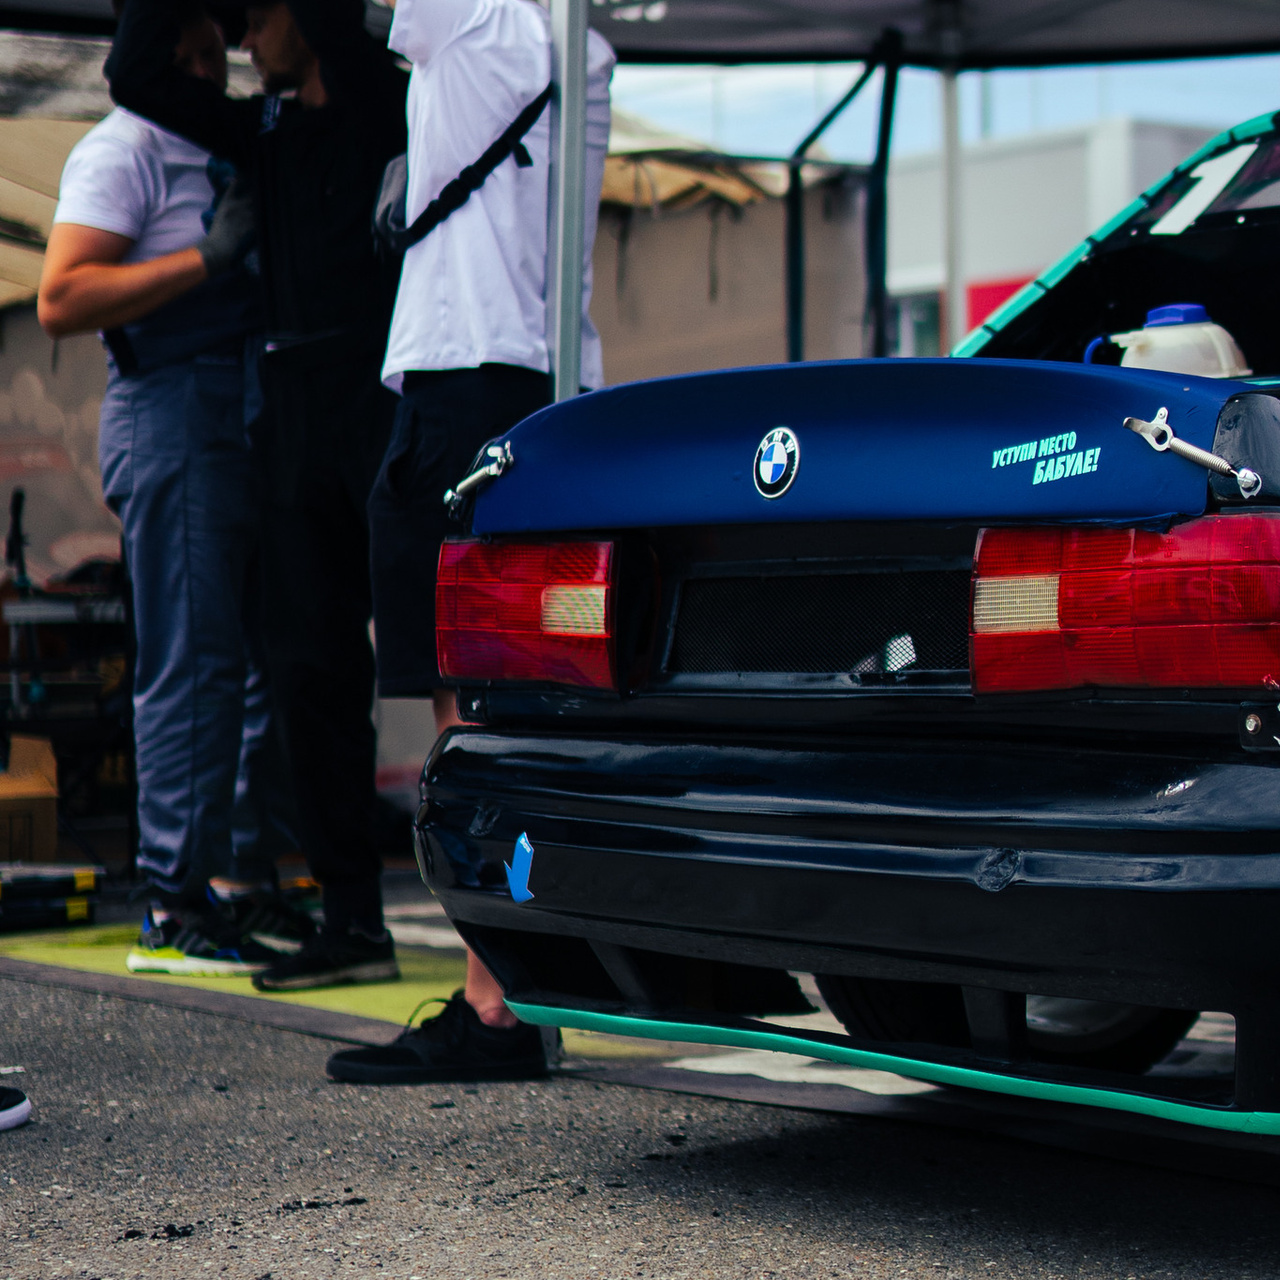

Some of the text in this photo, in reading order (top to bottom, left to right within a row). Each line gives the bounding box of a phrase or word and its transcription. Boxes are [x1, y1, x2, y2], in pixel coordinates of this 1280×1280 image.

[1149, 144, 1259, 235] 1
[991, 431, 1077, 469] УСТУПИ МЕСТО
[1032, 447, 1101, 486] БАБУЛЕ!
